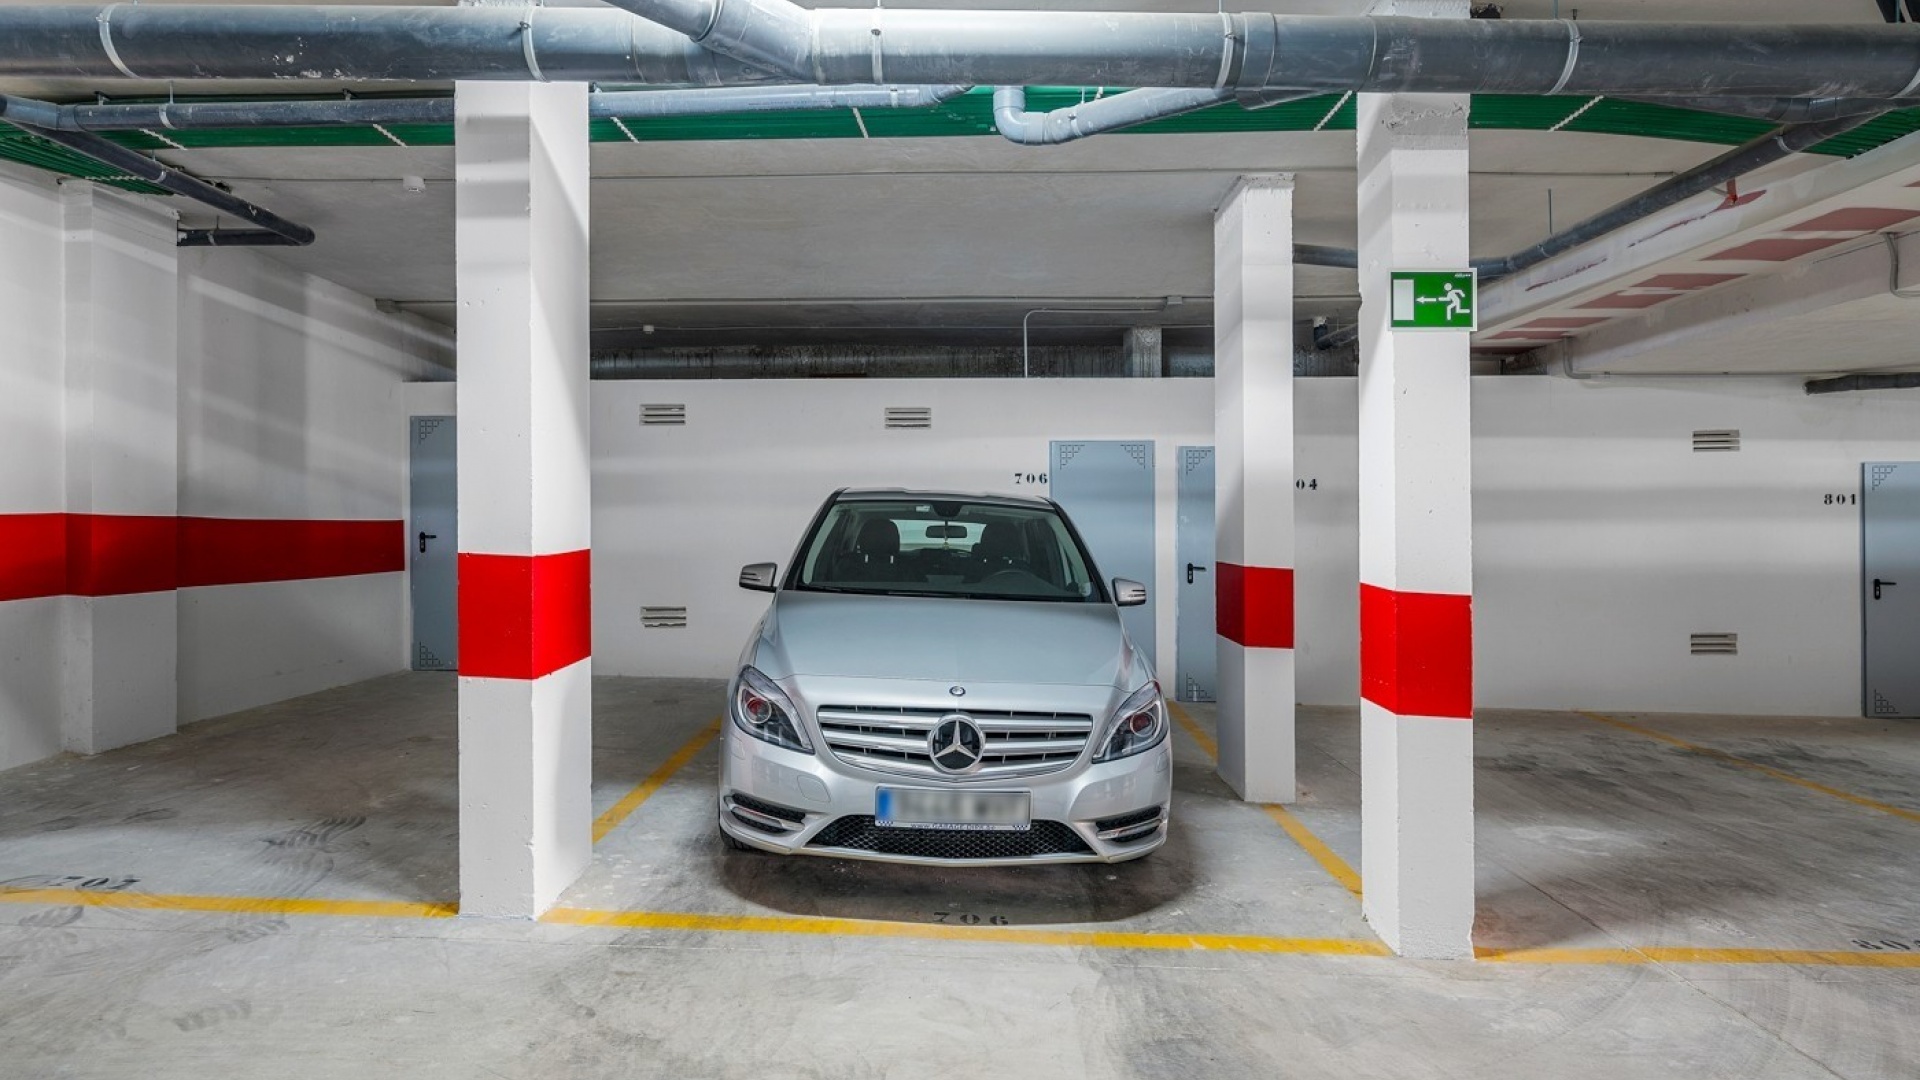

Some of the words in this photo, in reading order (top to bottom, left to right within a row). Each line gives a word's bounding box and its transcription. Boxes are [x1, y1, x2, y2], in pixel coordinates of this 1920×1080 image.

[1014, 472, 1048, 484] 706
[1295, 478, 1318, 491] 04
[1823, 493, 1857, 506] 801
[933, 911, 1009, 925] 706
